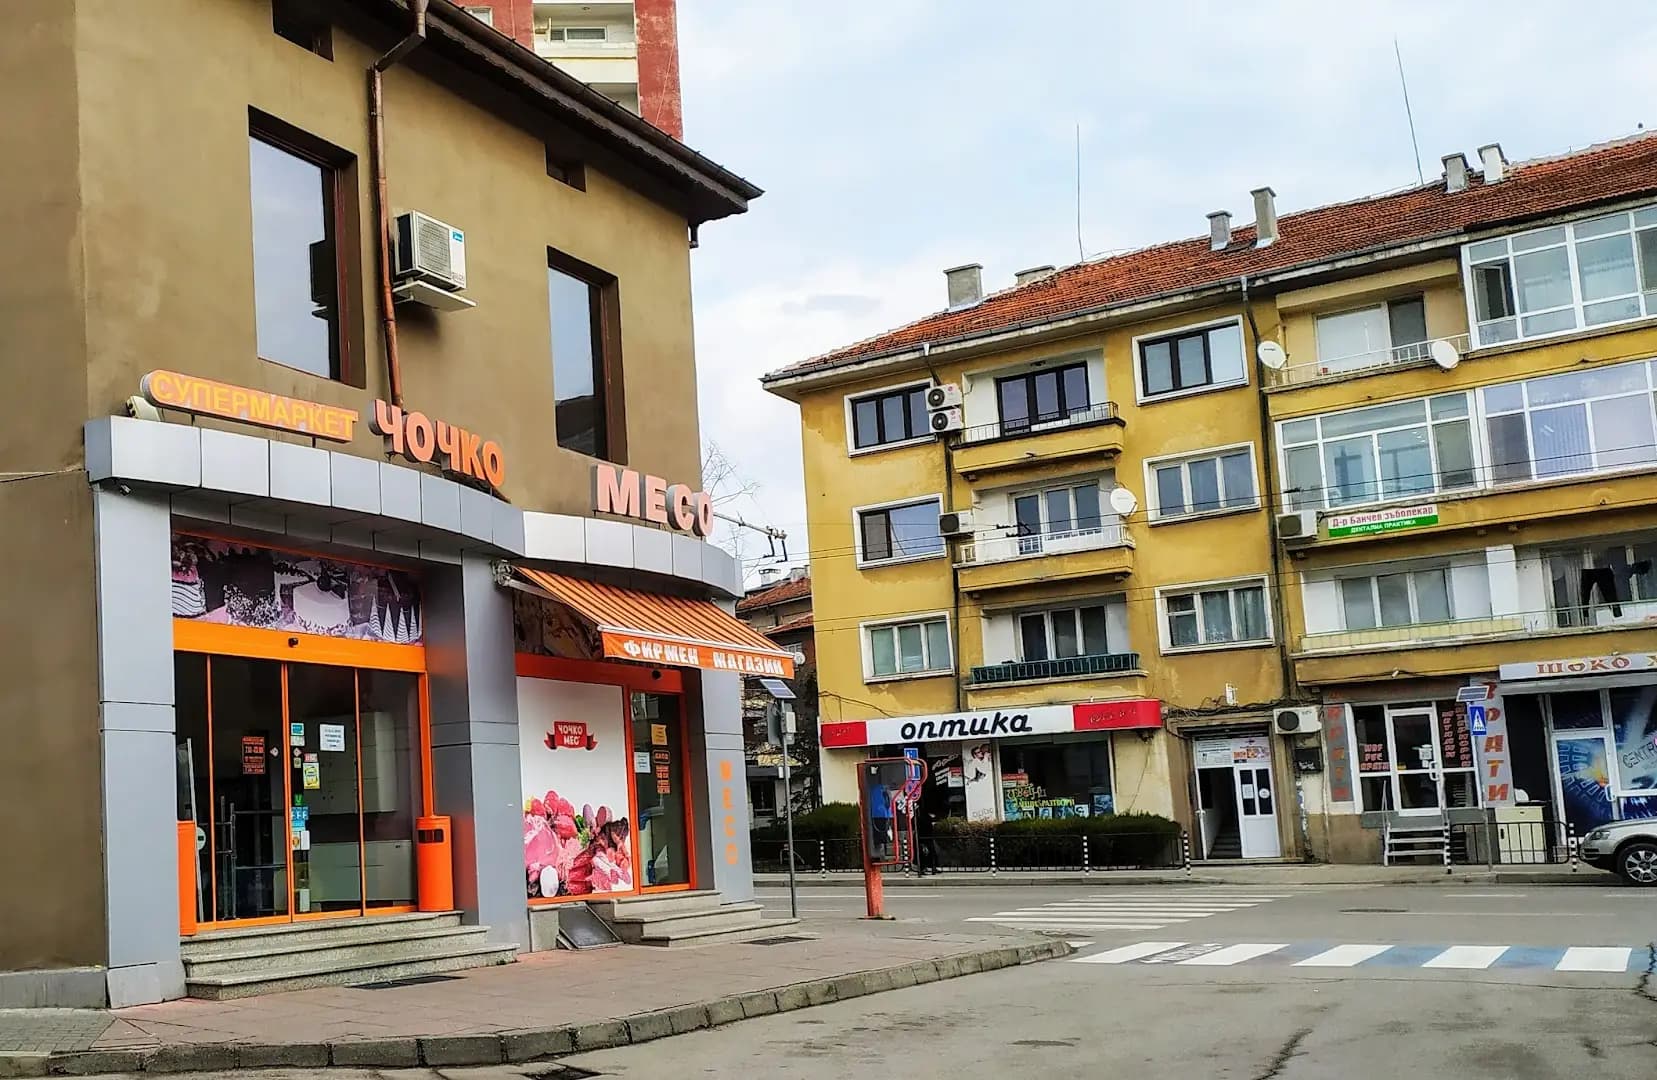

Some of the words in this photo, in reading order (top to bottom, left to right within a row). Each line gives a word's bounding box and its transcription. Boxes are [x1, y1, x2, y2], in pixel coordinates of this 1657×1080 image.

[151, 371, 357, 438] СУПЕРМАРКЕТ
[373, 398, 506, 489] ЧОЧКО
[594, 463, 714, 538] МЕСО
[1332, 517, 1348, 528] Д-р
[1383, 519, 1417, 529] ПРАКТИКА
[623, 639, 699, 665] ФИРМЕН
[713, 651, 785, 675] МАГАЗИН
[557, 724, 583, 736] ЧОЧКО
[900, 711, 1033, 740] оптика
